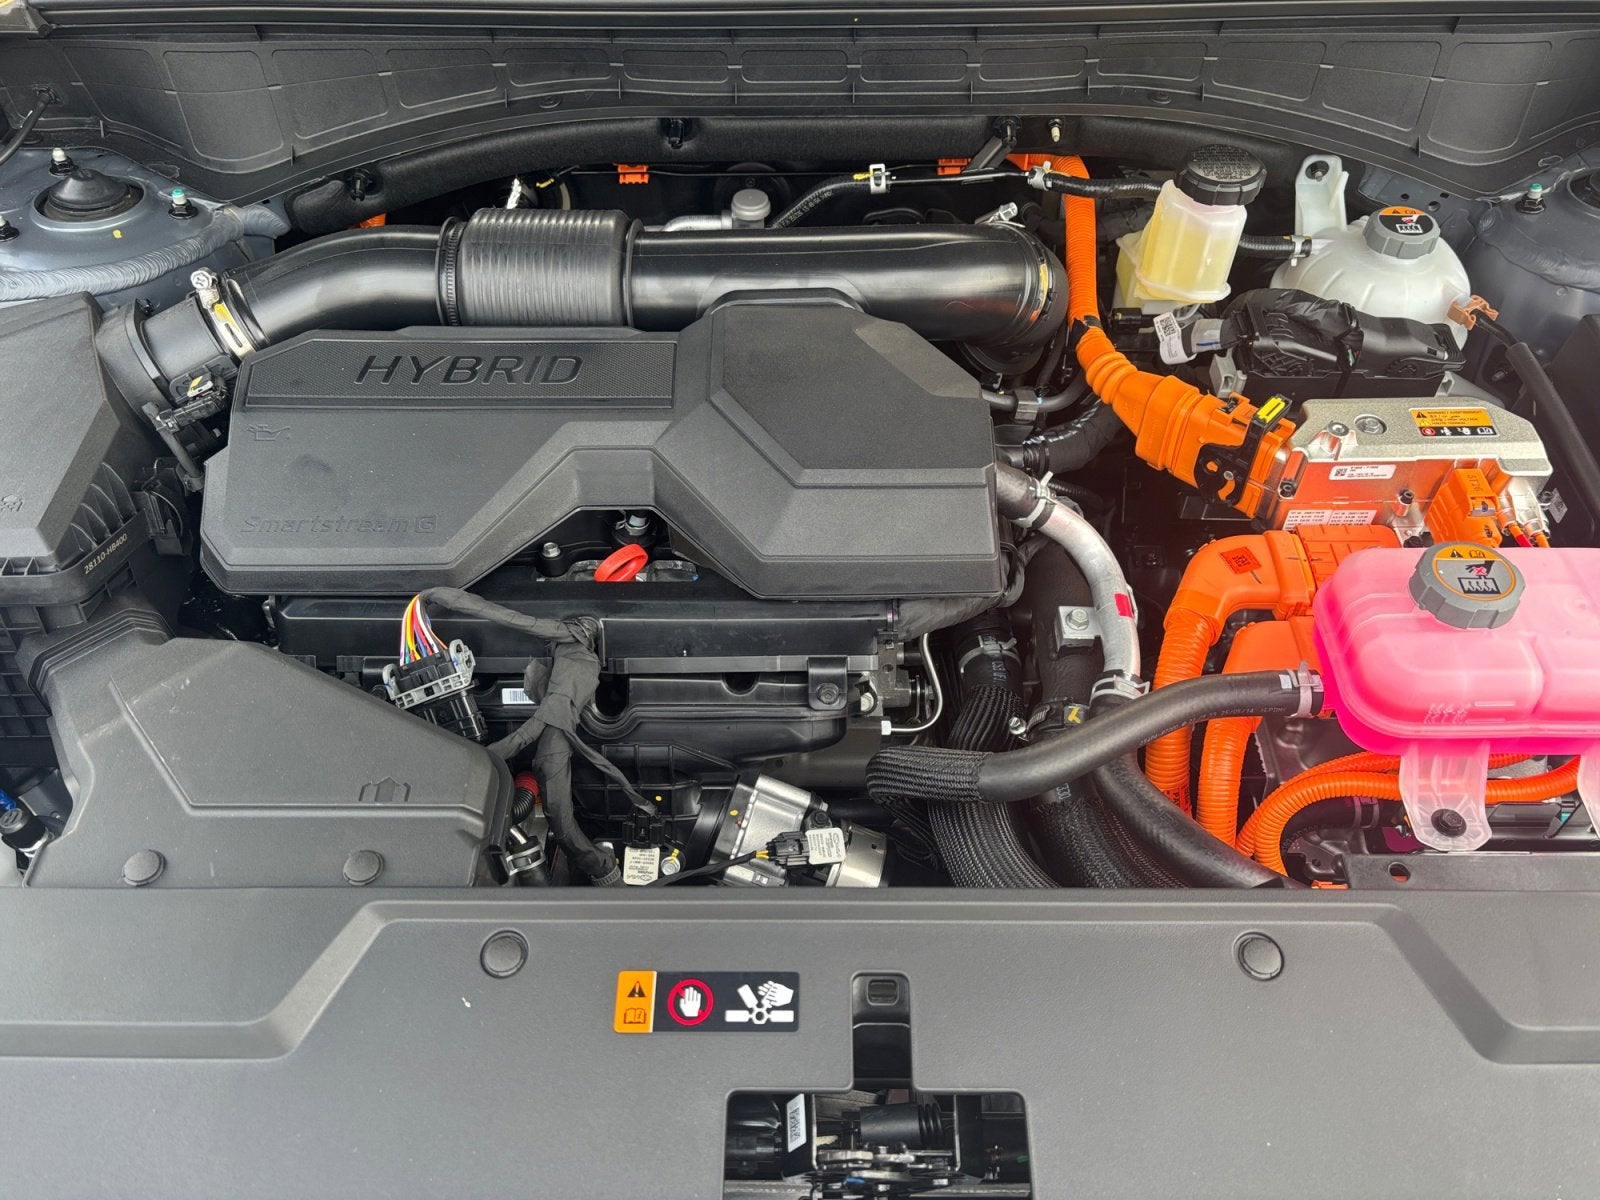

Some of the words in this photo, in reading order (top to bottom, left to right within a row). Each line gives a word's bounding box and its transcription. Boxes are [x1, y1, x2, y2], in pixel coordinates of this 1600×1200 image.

[354, 354, 583, 386] HYBRID
[240, 516, 410, 534] Smartstream
[415, 515, 437, 534] G
